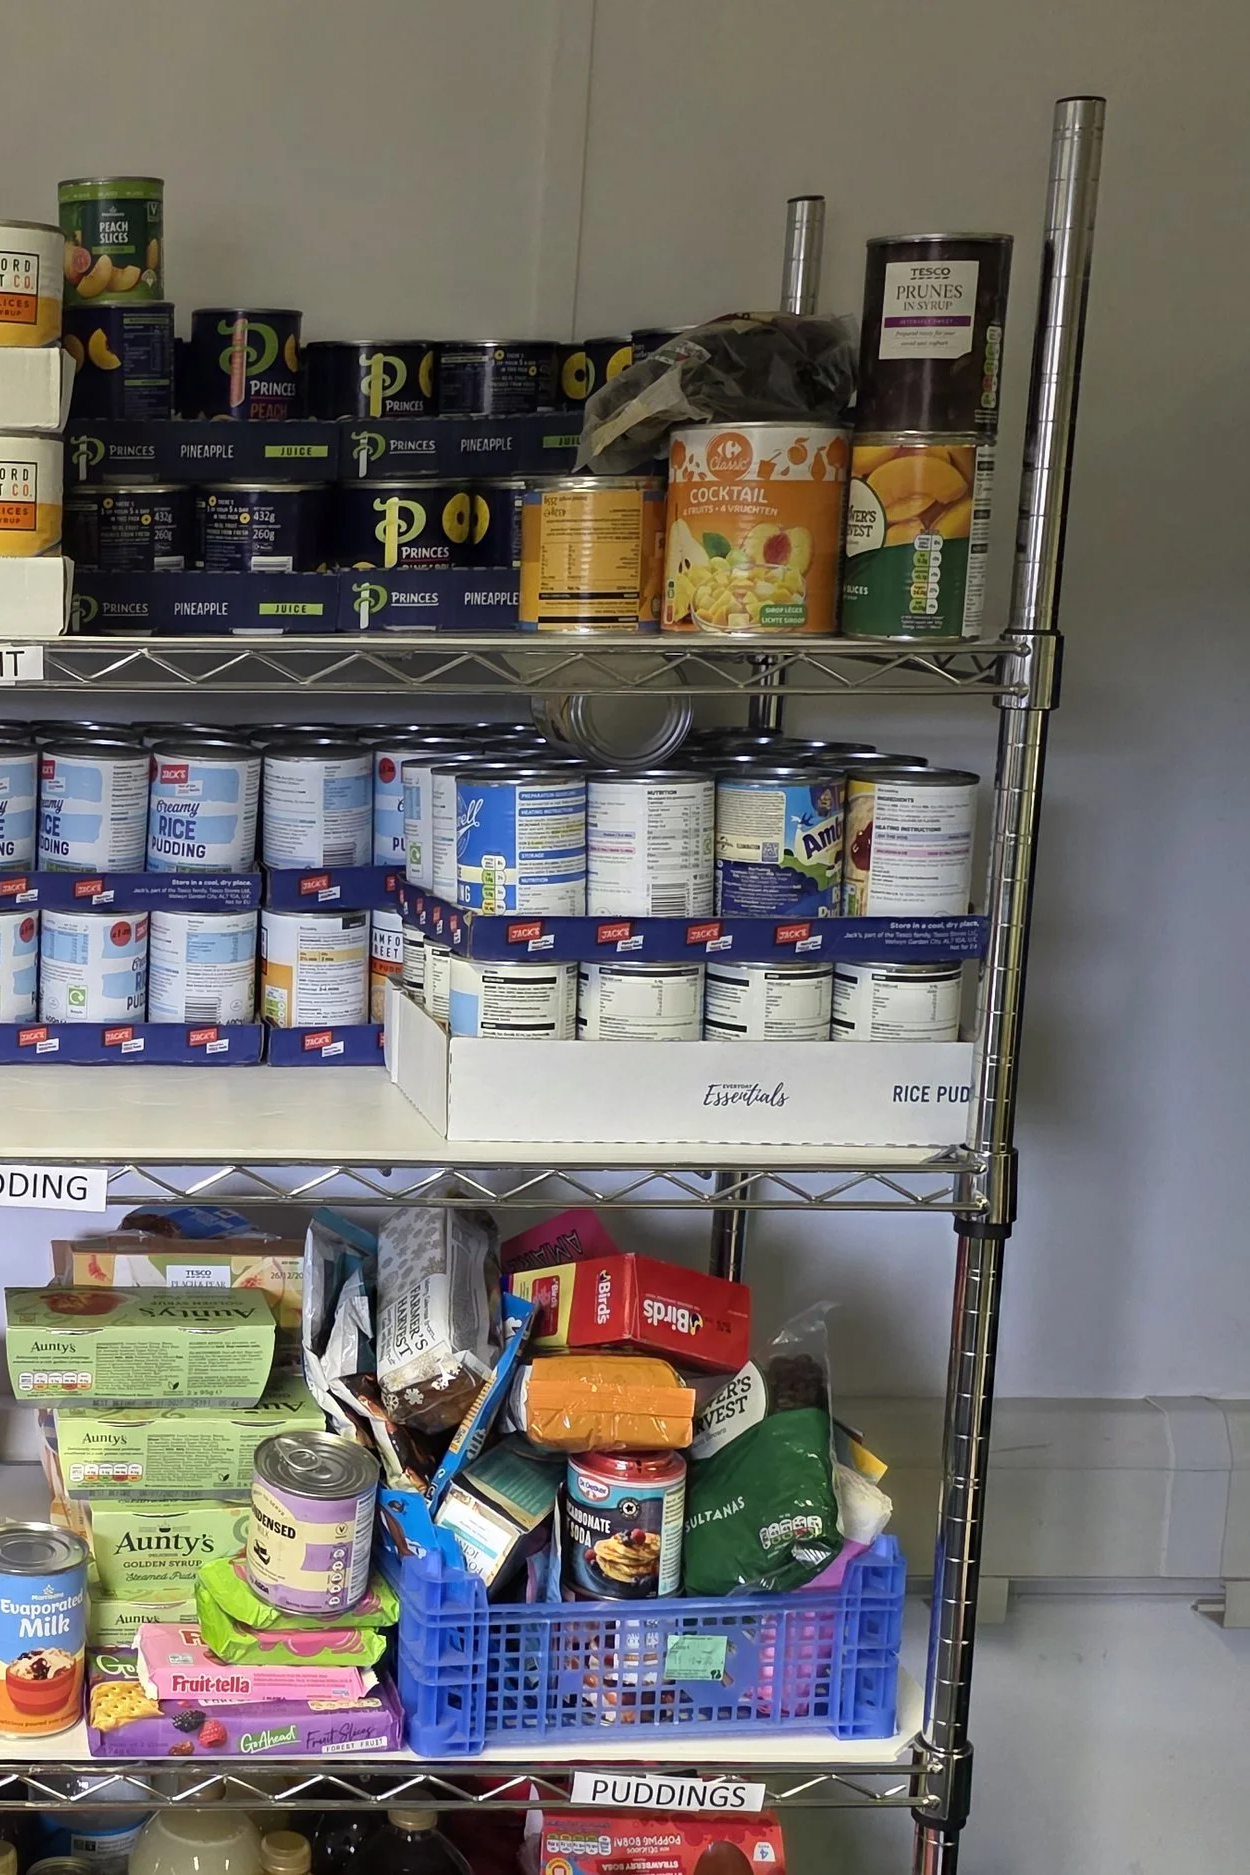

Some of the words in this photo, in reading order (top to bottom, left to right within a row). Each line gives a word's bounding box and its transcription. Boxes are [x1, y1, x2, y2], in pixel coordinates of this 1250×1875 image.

[99, 221, 129, 233] PEACH
[99, 231, 129, 245] SLICES
[911, 267, 951, 279] TESCO
[13, 275, 34, 290] CO.
[896, 284, 963, 300] PRUNES
[903, 301, 916, 311] IN
[917, 300, 953, 311] SYRUP
[250, 379, 296, 397] PRINCES
[250, 403, 288, 419] PEACH
[109, 444, 155, 456] PRINCES
[180, 444, 234, 459] PINEAPPLE
[280, 446, 313, 456] JUICE
[389, 439, 437, 451] PRINCES
[460, 437, 513, 453] PINEAPPLE
[709, 457, 749, 471] Classic
[11, 483, 33, 498] CO.
[690, 486, 768, 503] COCKTAIL
[253, 511, 276, 523] 432g
[728, 505, 778, 517] VRUCHTEN
[253, 529, 276, 541] 260g
[402, 546, 450, 559] PRINCES
[391, 591, 439, 604] PRINCES
[464, 592, 520, 606] PINEAPPLE
[102, 603, 149, 614] PRINCES
[174, 602, 229, 616] PINEAPPLE
[274, 604, 307, 614] JUICE
[156, 799, 201, 818] Creamy
[158, 815, 197, 841] RICE
[151, 836, 206, 859] PUDDING
[521, 852, 545, 860] STORAGE
[511, 927, 541, 939] JACK'S
[600, 927, 631, 939] JACK'S
[778, 927, 807, 939] JACK'S
[890, 922, 911, 930] Store
[690, 927, 720, 940] JACK'S
[703, 1081, 790, 1107] Essentials
[893, 1085, 931, 1103] RICE
[936, 1085, 971, 1104] PUD
[185, 1269, 212, 1279] TESCO
[270, 1271, 304, 1281] 26/12/20
[597, 1280, 612, 1326] Bird's
[139, 1306, 255, 1322] Aunty's
[409, 1284, 429, 1351] FARMER'S
[643, 1299, 690, 1334] Bird's
[395, 1296, 414, 1358] HARVEST
[30, 1340, 77, 1355] Aunty's
[82, 1432, 128, 1446] Aunty's
[684, 1496, 746, 1533] SULTANAS
[570, 1522, 592, 1547] SODA
[113, 1531, 215, 1557] Aunty's
[123, 1560, 167, 1568] GOLDEN
[168, 1559, 203, 1568] SYRUP
[125, 1571, 168, 1582] Steamed
[169, 1571, 197, 1580] Puds
[0, 1588, 84, 1620] Evaporated
[19, 1613, 71, 1638] Milk
[171, 1674, 251, 1694] Fruit-tella
[306, 1729, 336, 1750] Fruit
[337, 1722, 375, 1742] Slices
[326, 1744, 356, 1753] FOREST
[360, 1738, 385, 1750] FRUIT
[592, 1779, 746, 1808] PUDDINGS
[643, 1834, 681, 1845] POPPING
[760, 1848, 769, 1860] 4
[601, 1863, 622, 1872] BOBA
[623, 1861, 679, 1871] STRAWBERRY
